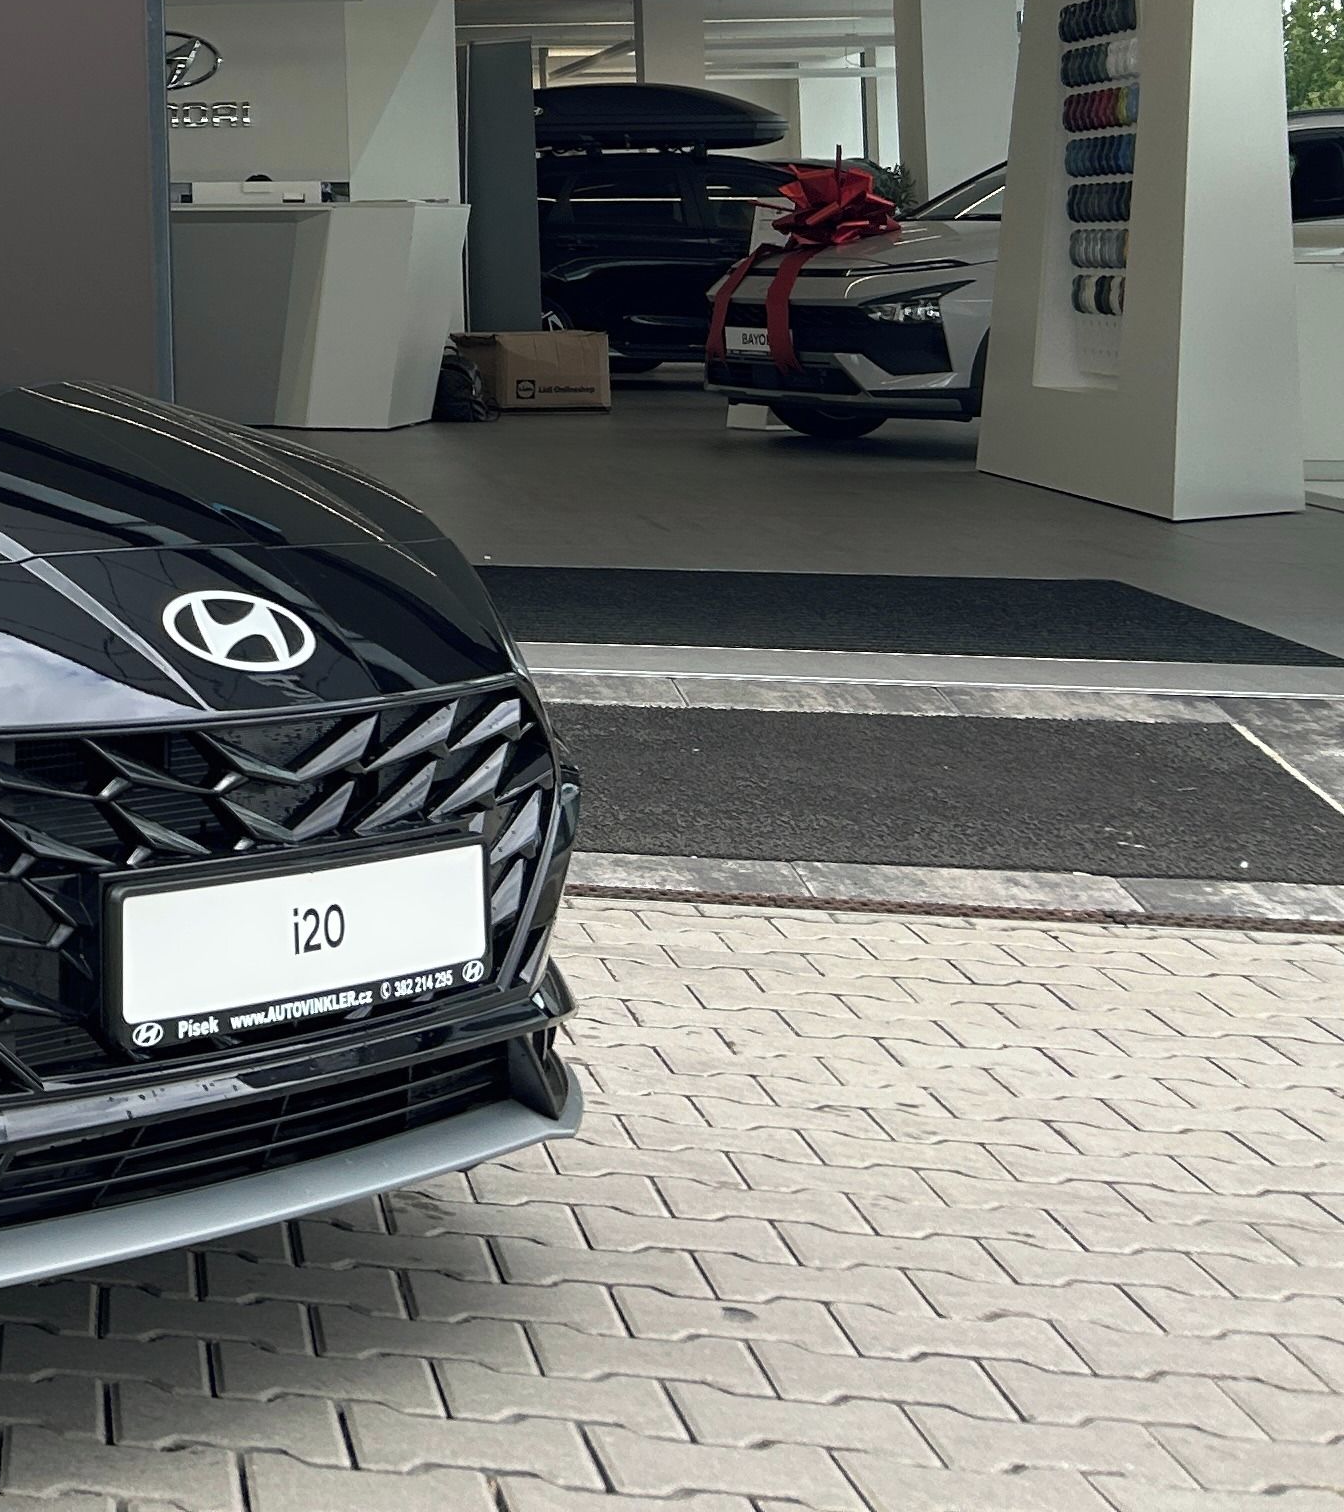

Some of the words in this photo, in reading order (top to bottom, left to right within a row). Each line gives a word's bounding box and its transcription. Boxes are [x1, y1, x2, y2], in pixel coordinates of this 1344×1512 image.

[741, 332, 769, 345] BAYO
[291, 902, 346, 956] i20
[178, 1016, 220, 1040] Písek
[230, 990, 373, 1030] www.AUTOVINKLER.cz
[394, 978, 414, 997] 382
[414, 974, 434, 993] 214
